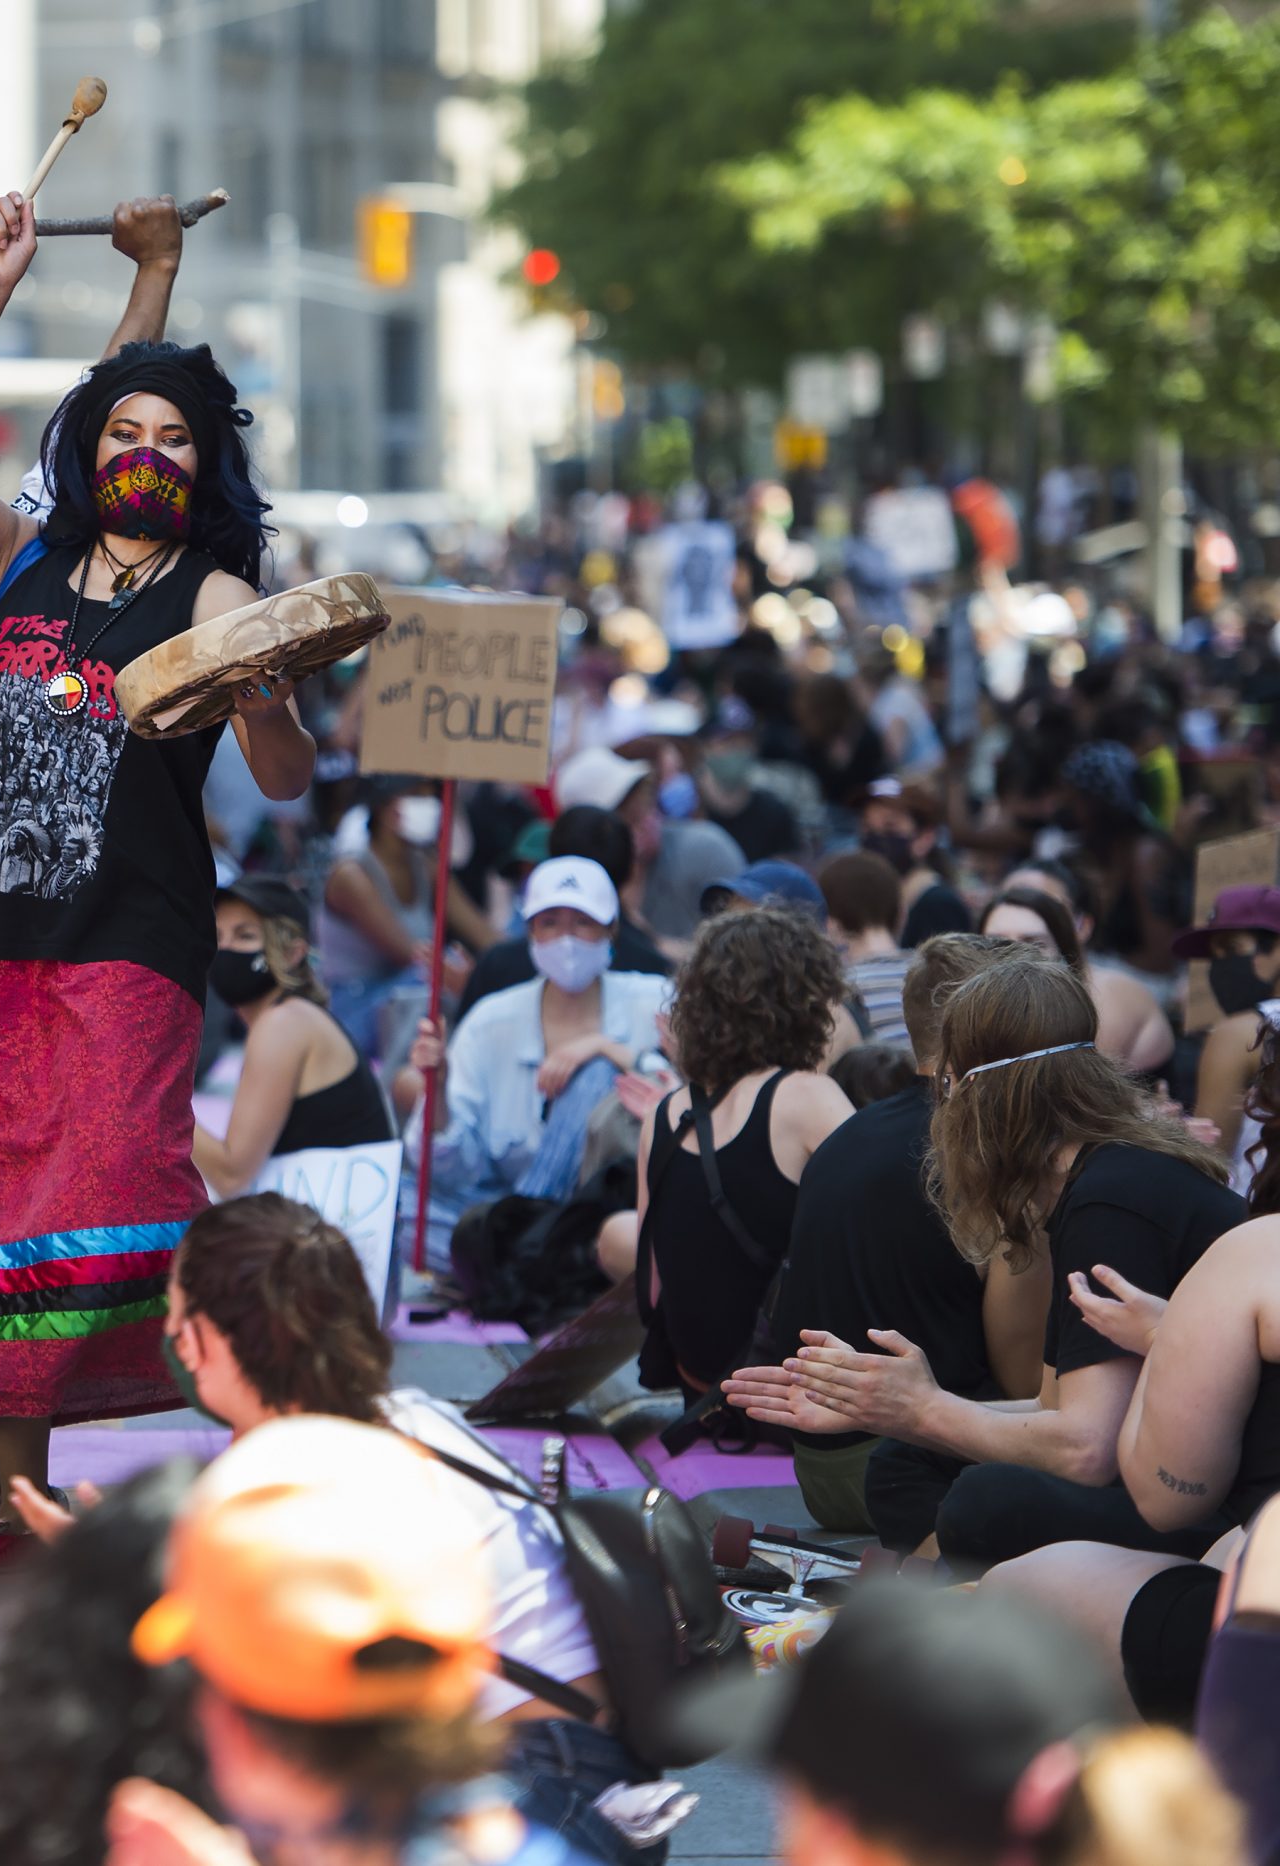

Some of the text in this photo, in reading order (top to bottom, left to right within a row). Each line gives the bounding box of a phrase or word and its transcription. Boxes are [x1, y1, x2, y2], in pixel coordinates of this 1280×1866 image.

[8, 614, 69, 640] THE
[414, 630, 551, 685] PEOPLE
[378, 678, 546, 748] NOT POLICE
